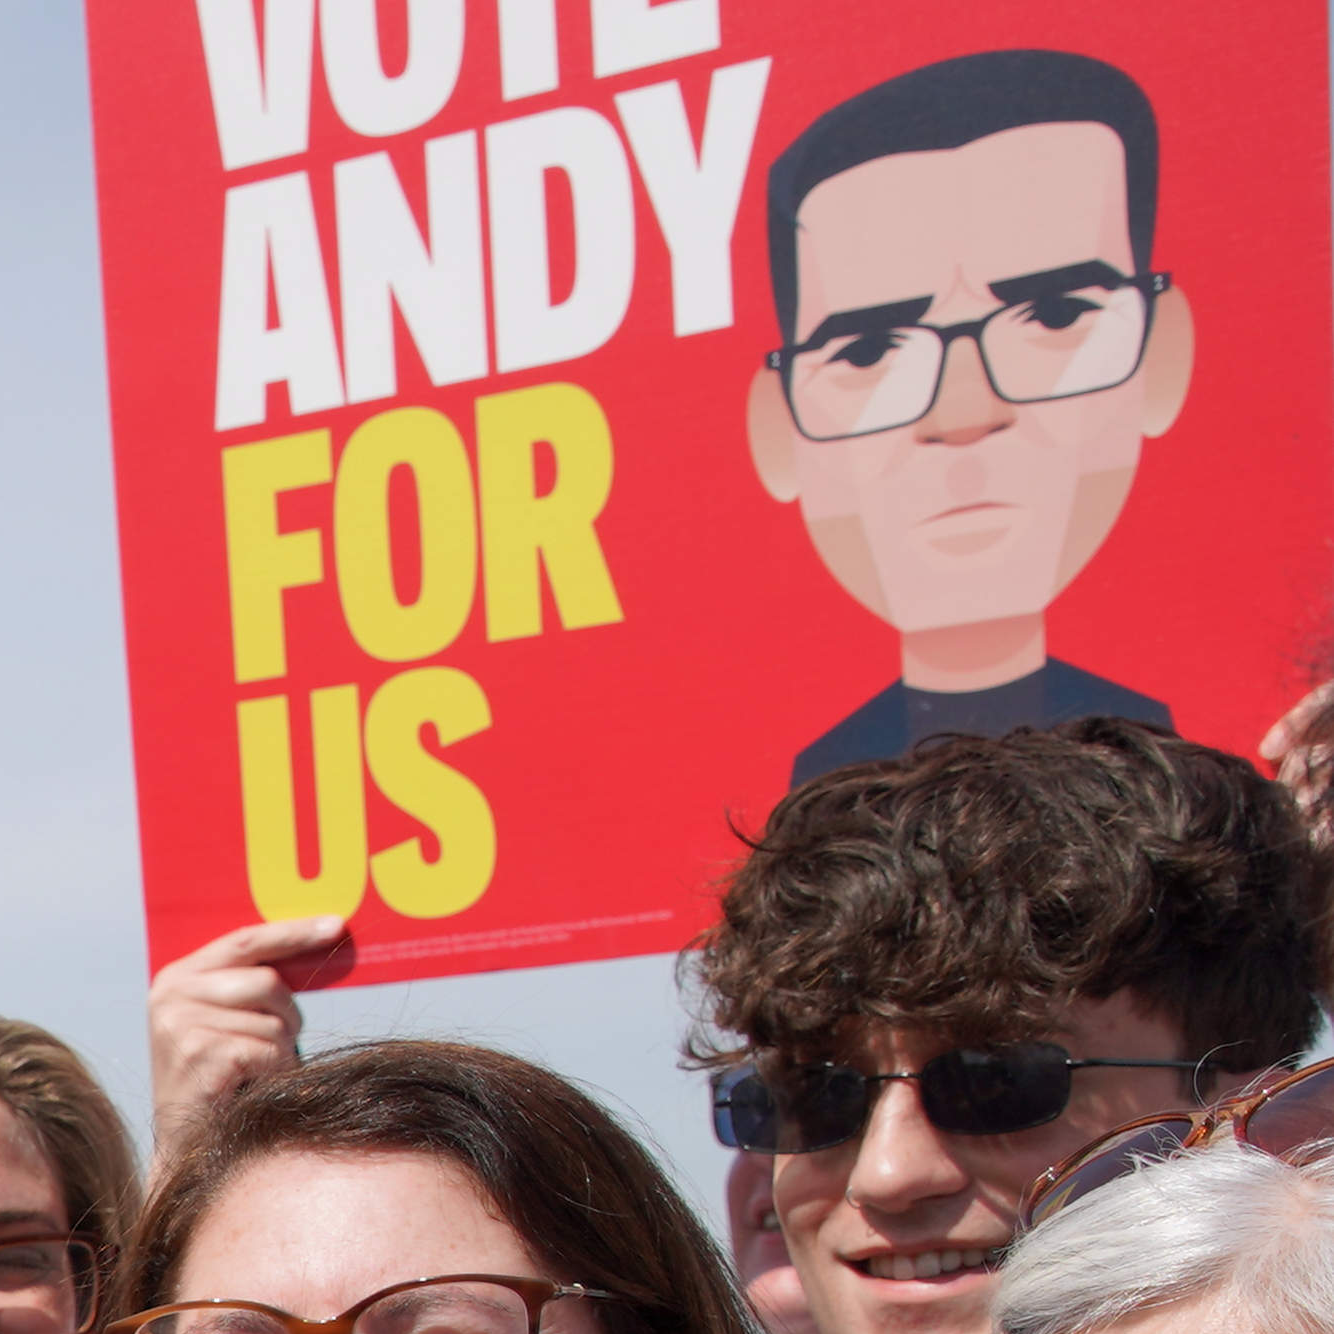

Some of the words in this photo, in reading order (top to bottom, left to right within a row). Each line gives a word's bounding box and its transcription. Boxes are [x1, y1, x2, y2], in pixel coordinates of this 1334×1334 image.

[196, 0, 721, 171] VO
[214, 56, 773, 432] ANDY
[221, 383, 625, 684] FOR
[236, 666, 497, 925] US
